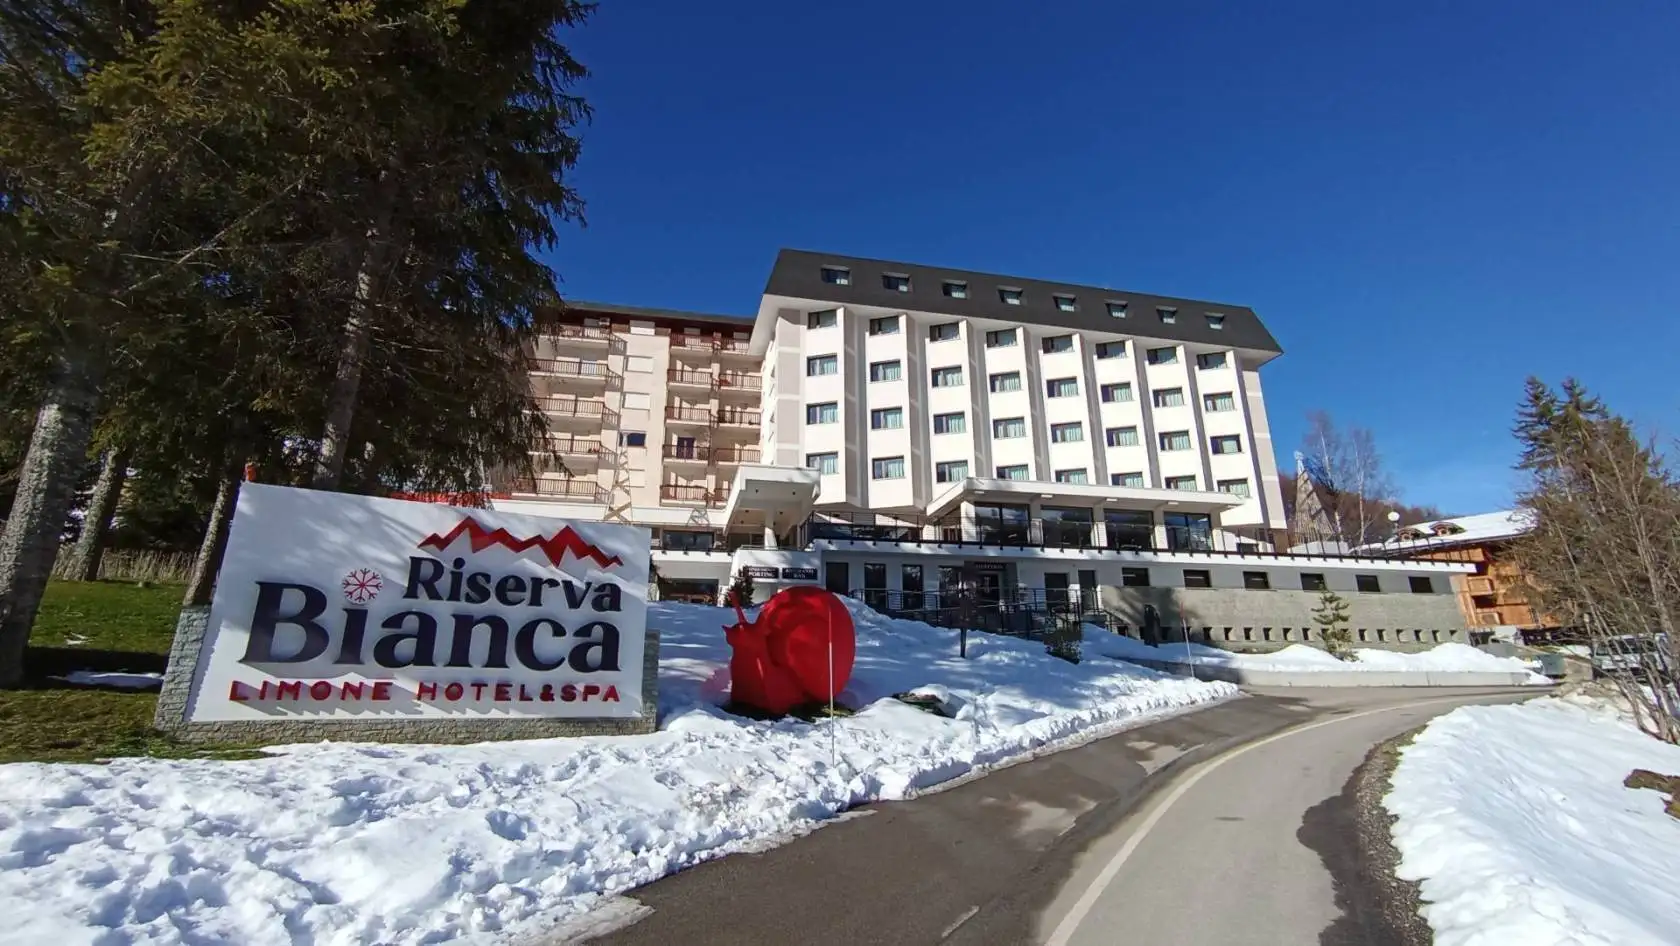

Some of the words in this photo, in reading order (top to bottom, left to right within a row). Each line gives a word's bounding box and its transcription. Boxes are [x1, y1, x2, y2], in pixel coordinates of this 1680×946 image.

[403, 556, 622, 612] Riserva
[238, 569, 622, 673] Bianca
[229, 680, 394, 701] LIMONE
